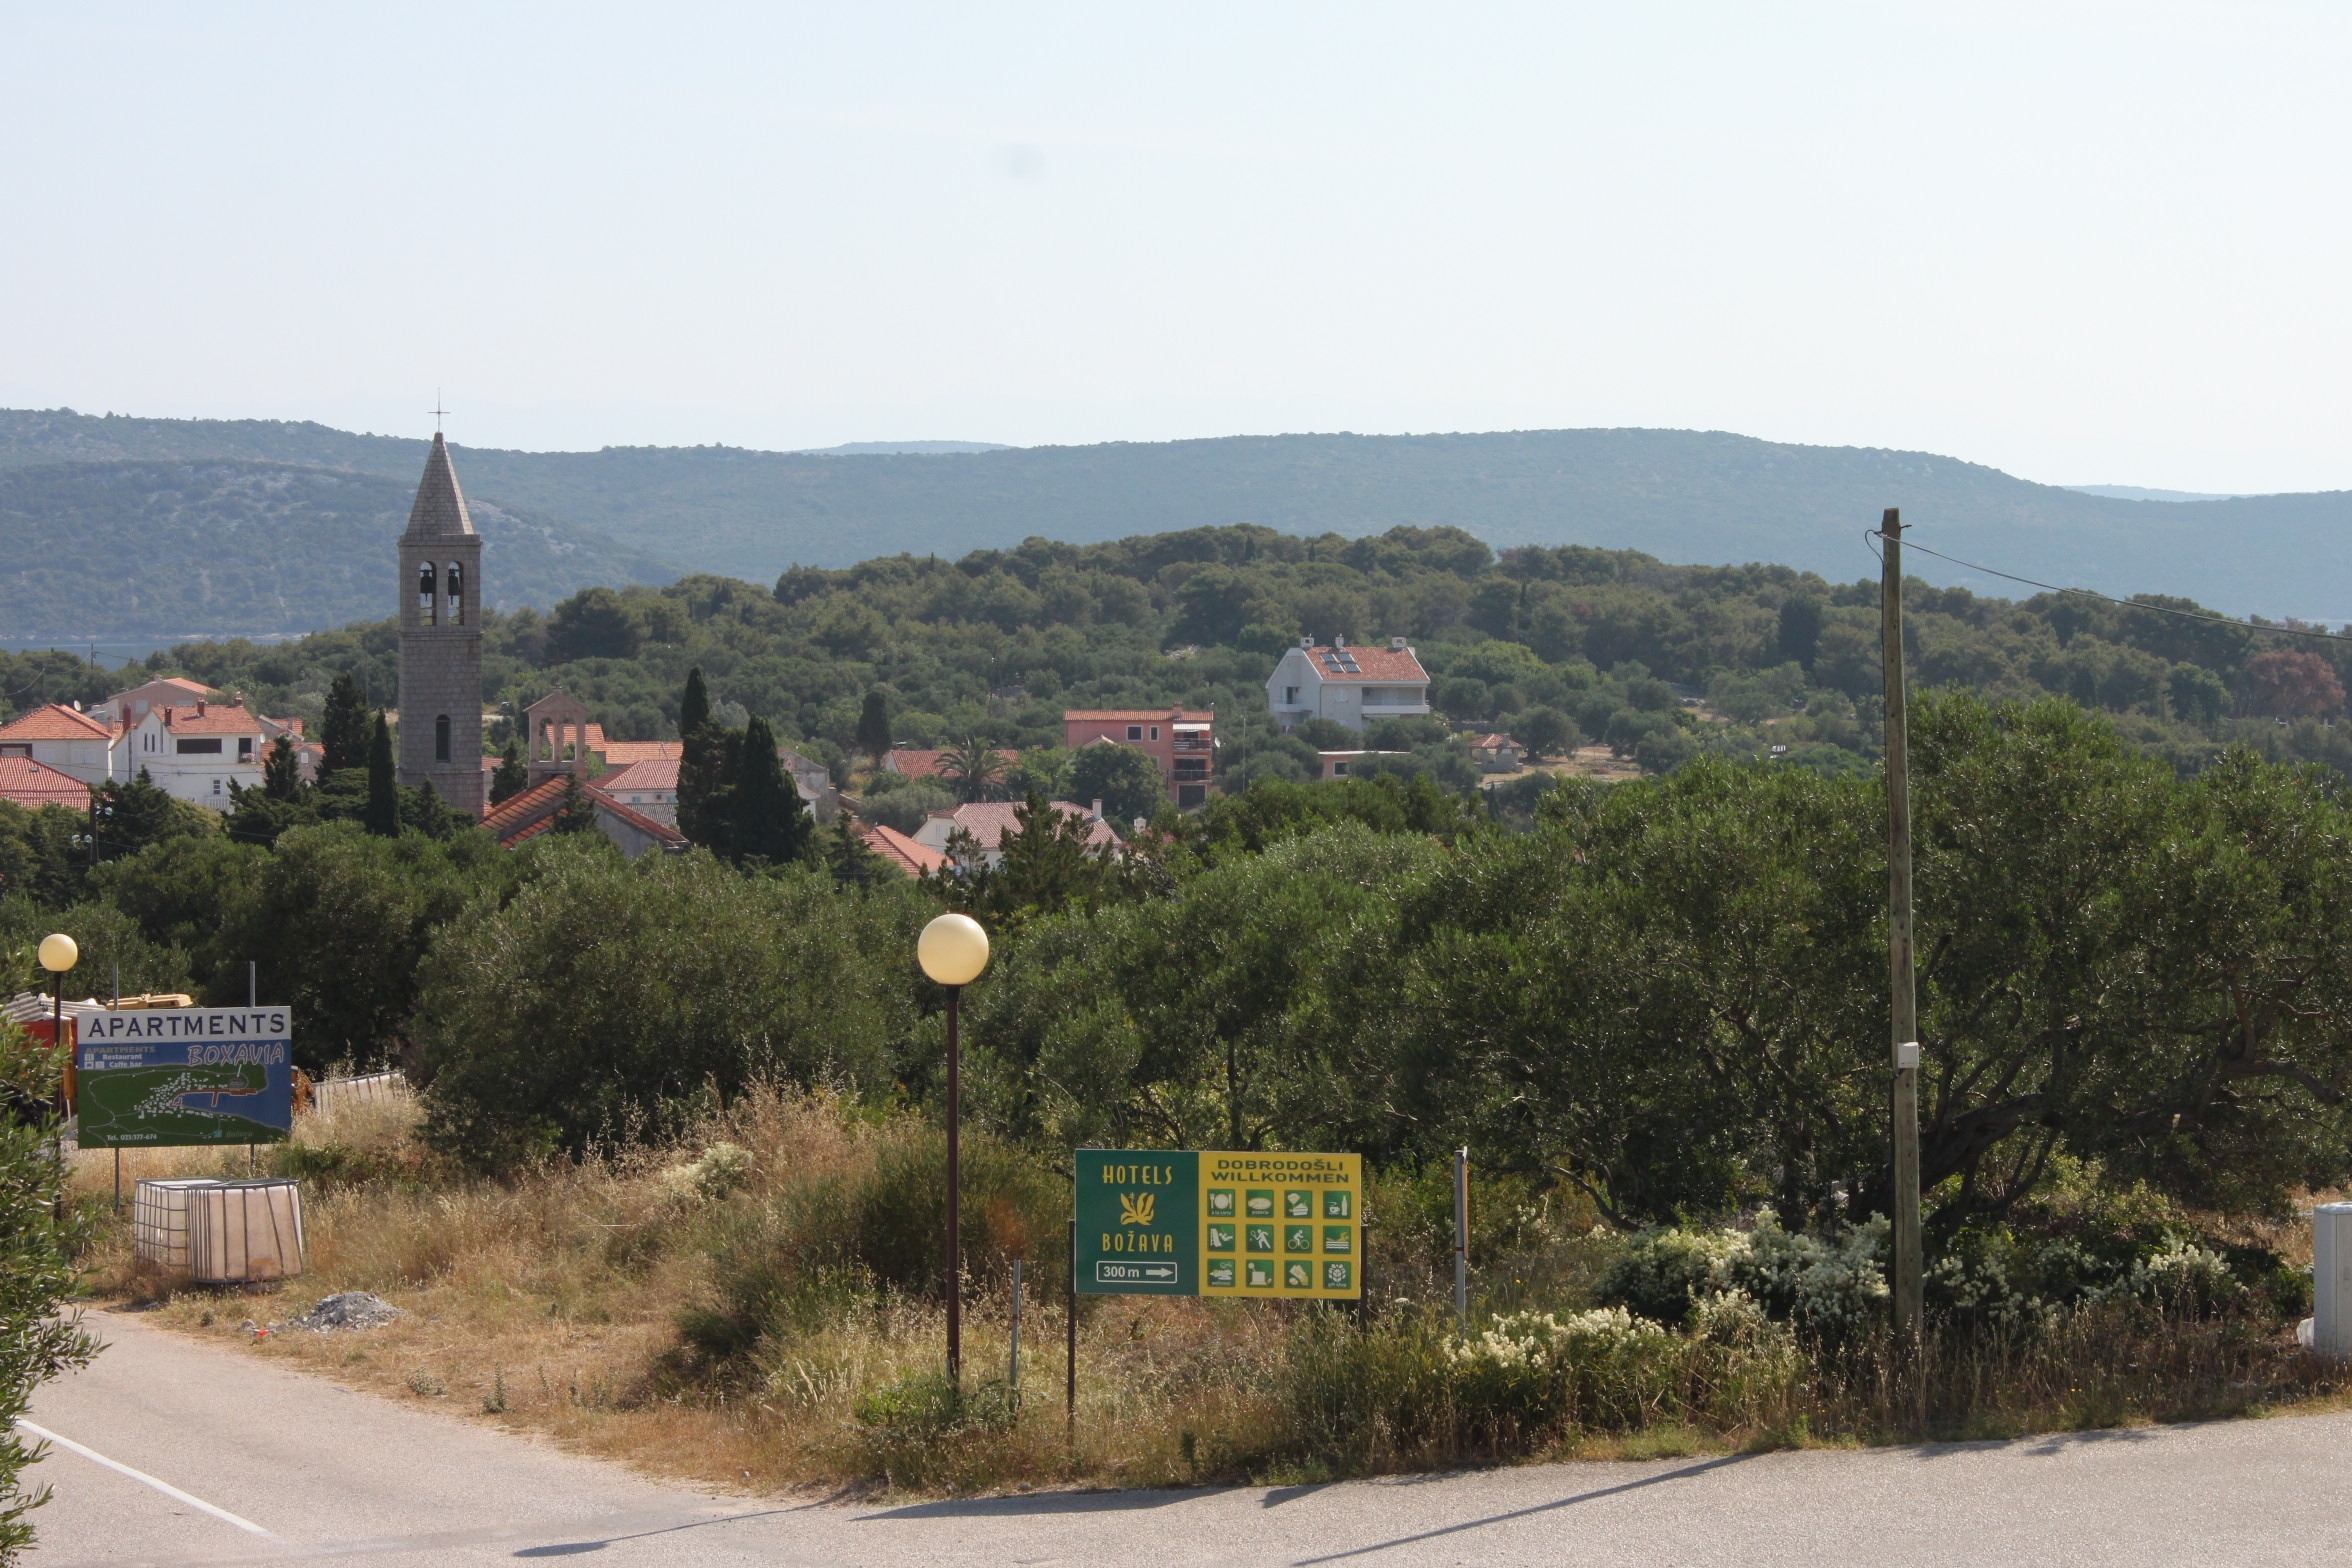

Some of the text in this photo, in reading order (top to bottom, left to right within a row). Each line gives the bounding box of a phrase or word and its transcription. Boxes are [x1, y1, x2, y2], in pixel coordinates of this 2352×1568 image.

[88, 1013, 284, 1038] APARTMENTS
[85, 1046, 156, 1055] APARTMENTS
[187, 1042, 285, 1067] BOXAVIA
[102, 1053, 142, 1061] Restaurant
[129, 1060, 143, 1068] bar
[1217, 1159, 1344, 1171] DOBRODOŠLI
[1102, 1165, 1173, 1185] HOTELS
[1211, 1172, 1349, 1183] WILLKOMMEN
[1102, 1230, 1174, 1253] BOŽAVA
[1103, 1266, 1140, 1278] 300 m
